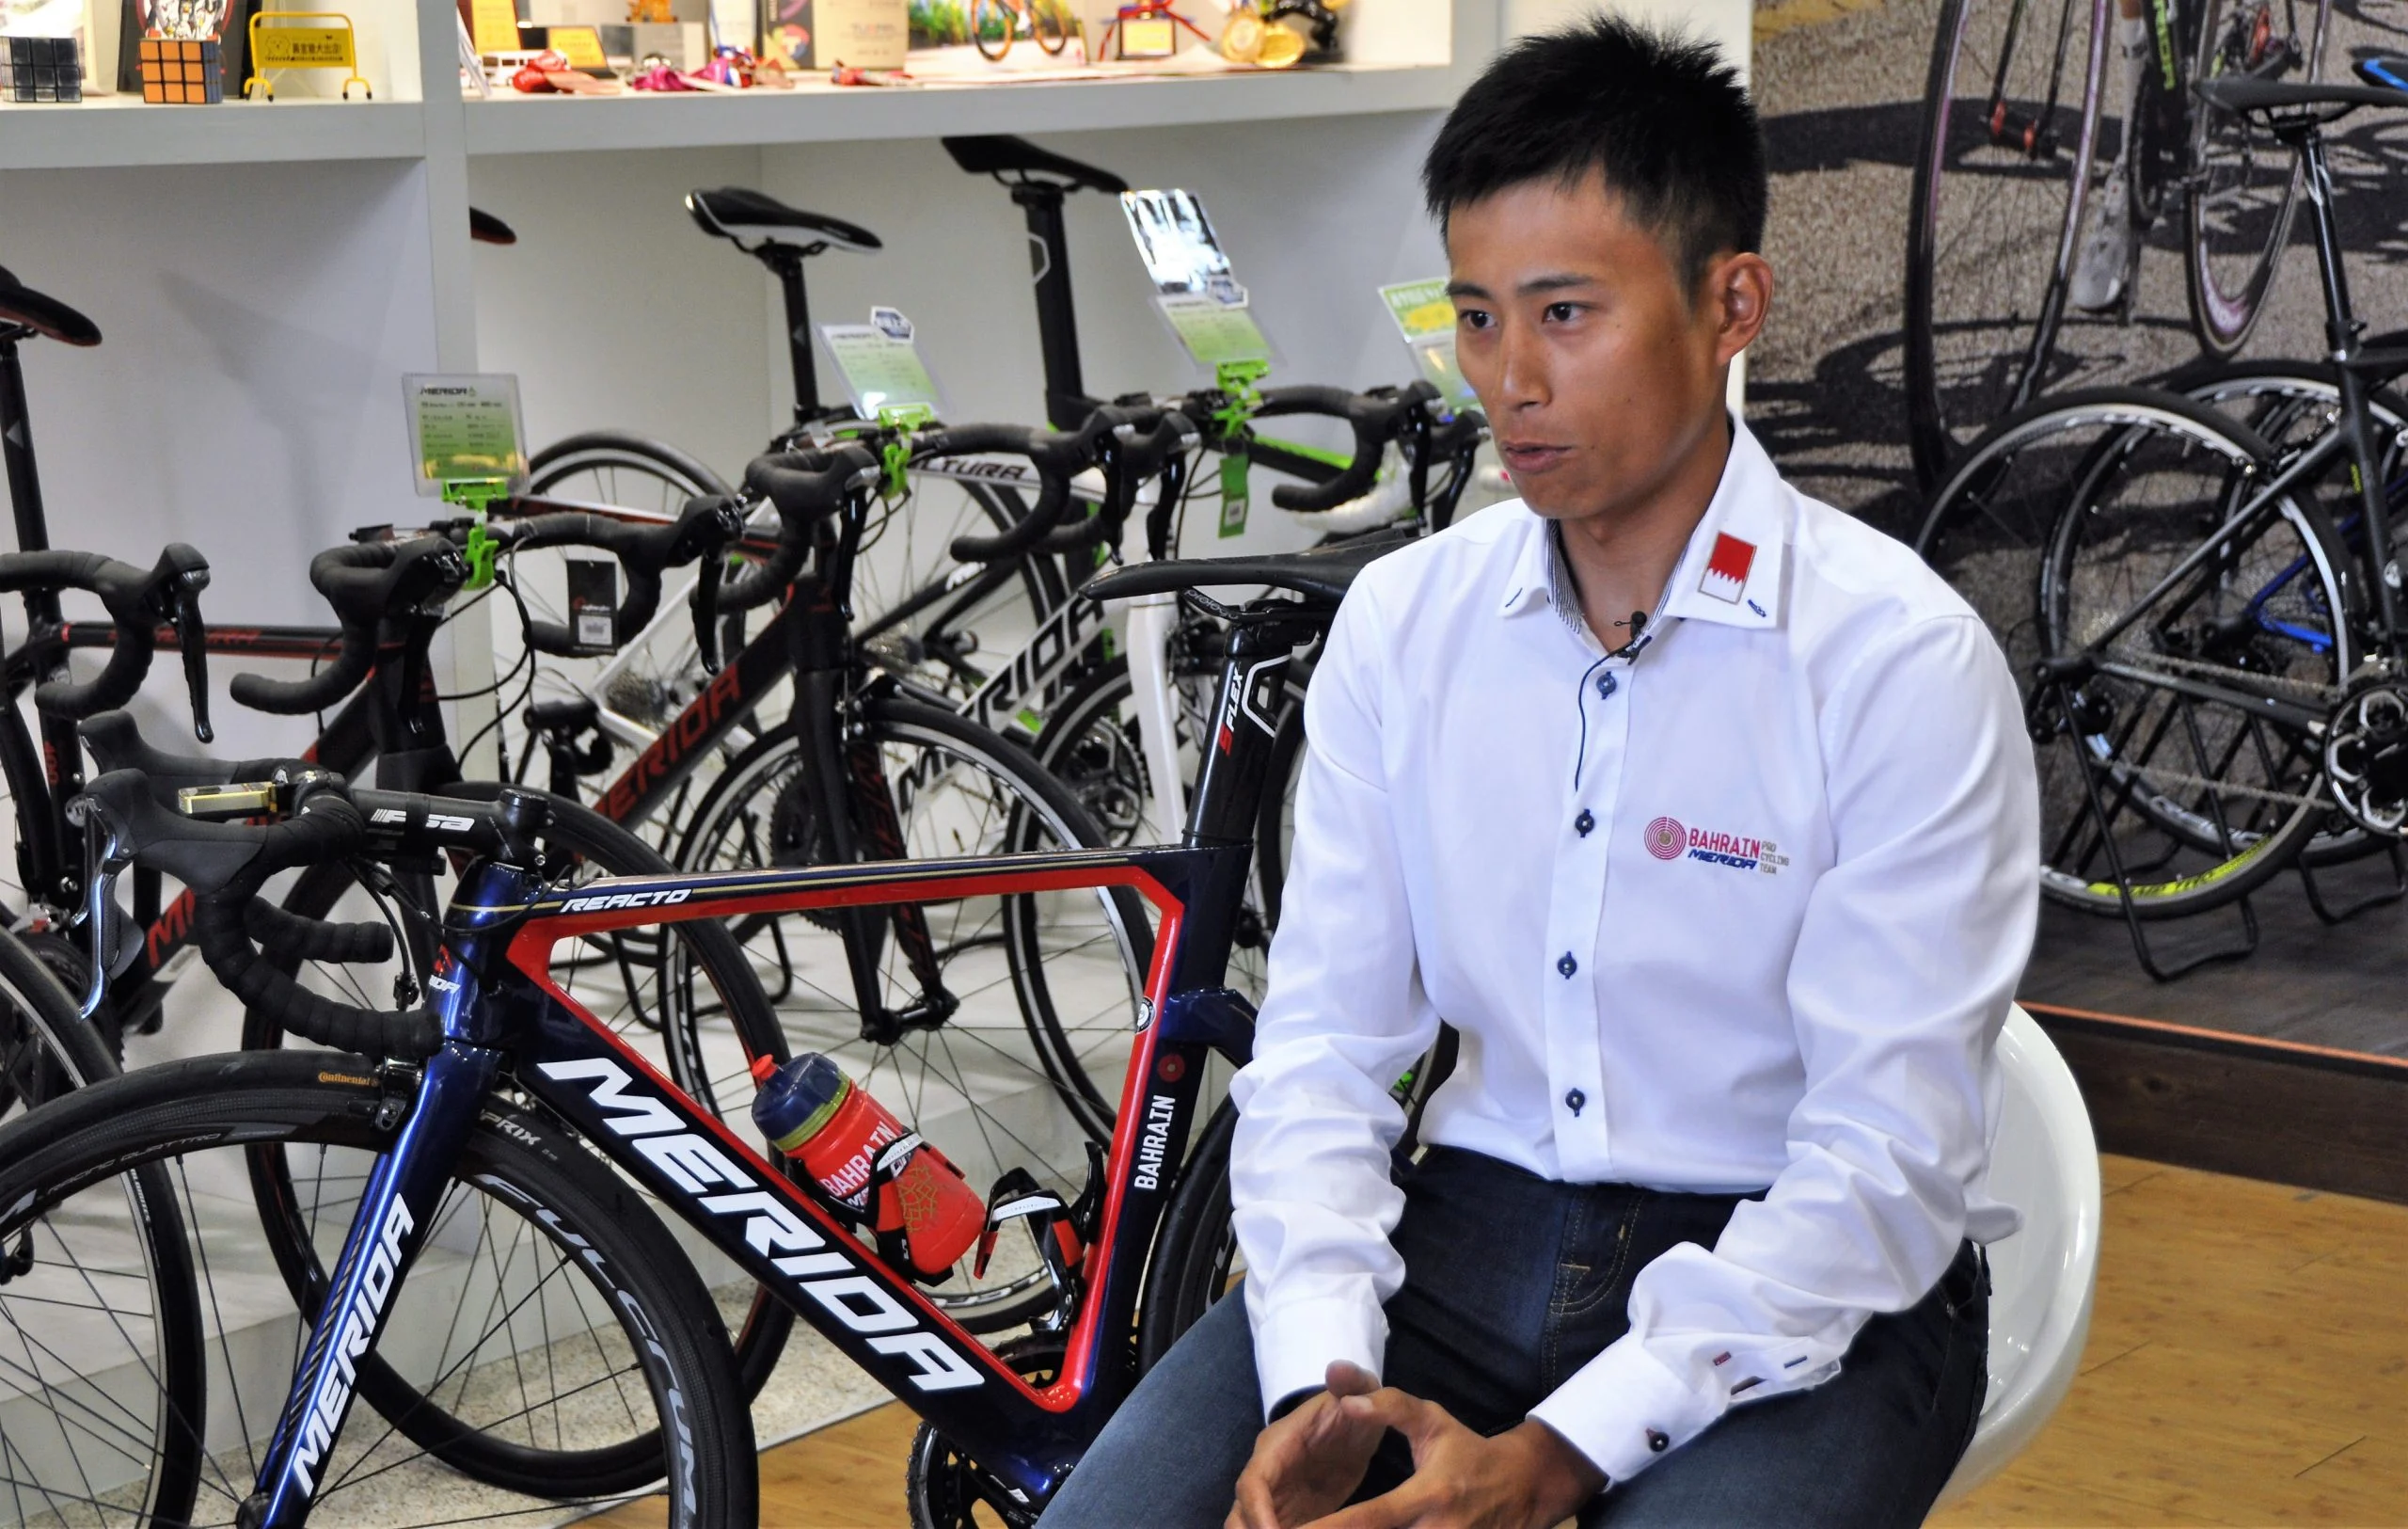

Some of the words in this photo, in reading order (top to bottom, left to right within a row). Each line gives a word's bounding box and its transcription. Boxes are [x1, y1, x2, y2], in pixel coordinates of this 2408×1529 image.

[593, 661, 741, 821] ERIDA
[1688, 827, 1761, 859] BAHRAIN
[1761, 840, 1777, 852] PRO
[1687, 849, 1757, 870] MERIDA
[1760, 852, 1789, 867] CYCLING
[1760, 863, 1777, 875] TEAM
[560, 888, 691, 913] REACTO
[318, 1072, 370, 1086] Continental
[1134, 1094, 1176, 1190] BAHRAIN
[536, 1057, 986, 1392] MERIDA
[292, 1192, 415, 1498] MERIDA
[474, 1173, 696, 1515] FULCRUM
